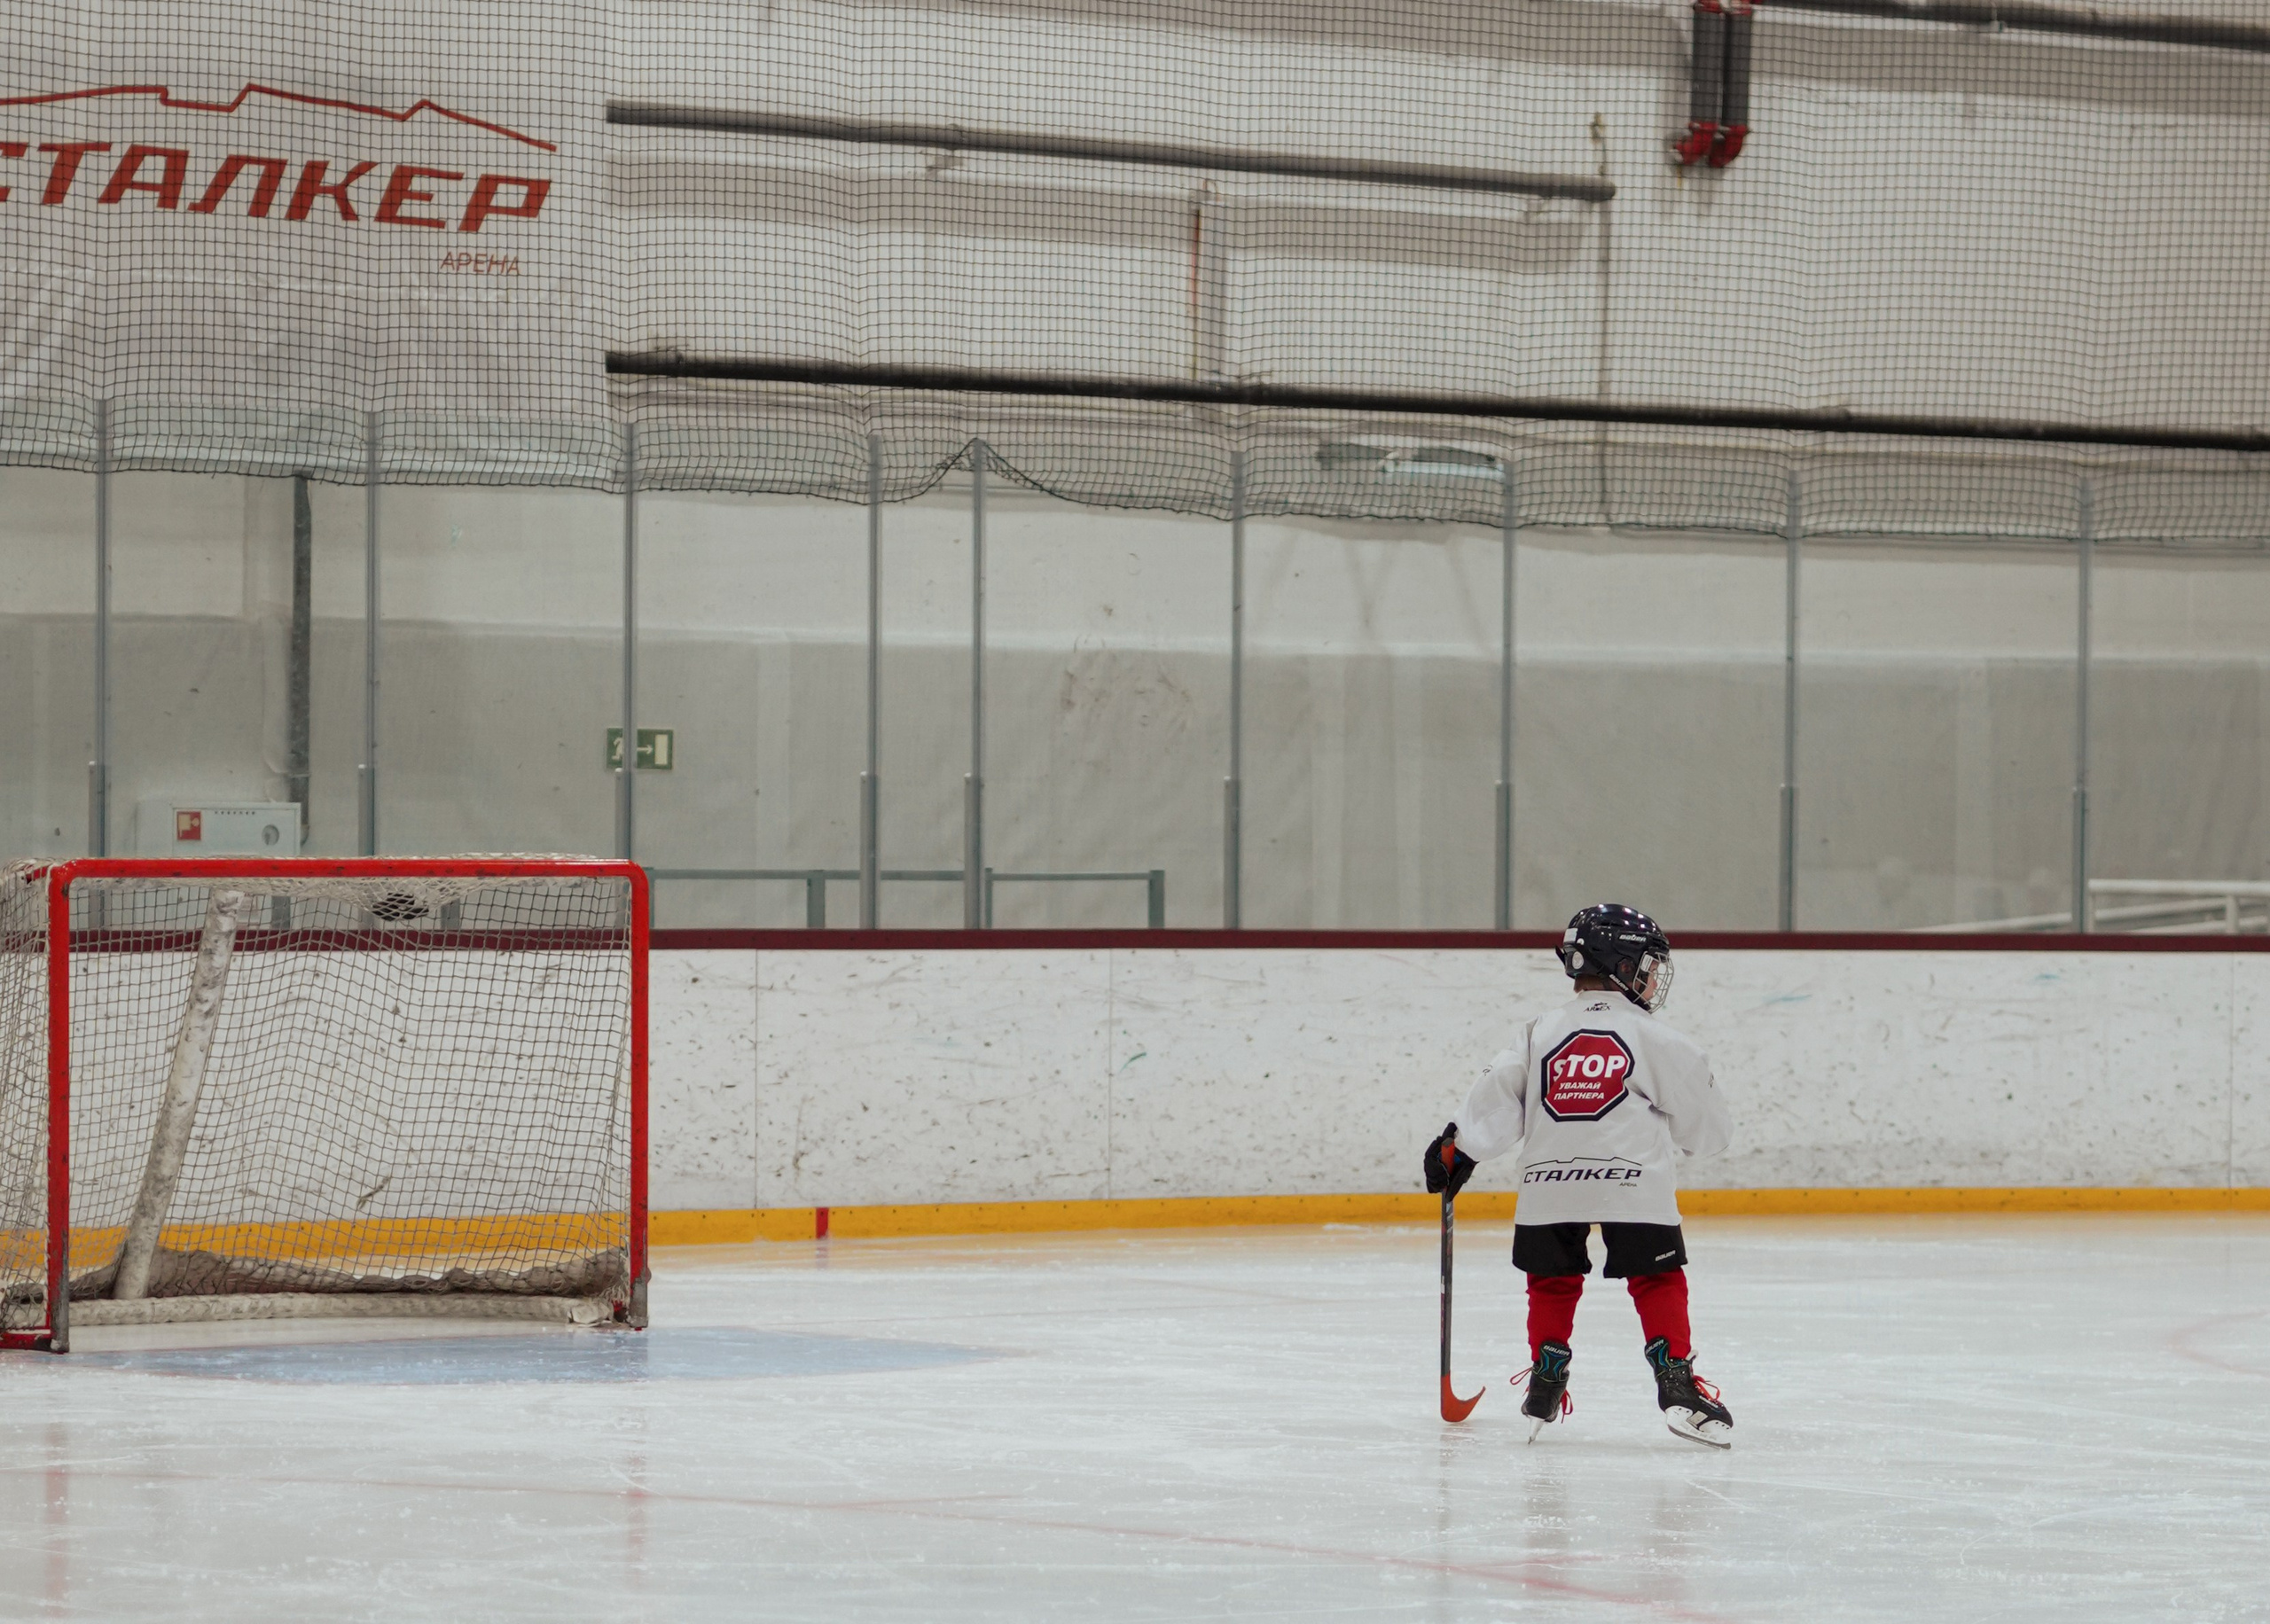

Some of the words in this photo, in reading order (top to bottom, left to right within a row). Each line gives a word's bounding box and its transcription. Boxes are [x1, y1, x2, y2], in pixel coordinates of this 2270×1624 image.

[441, 252, 521, 275] АРЕНА
[1554, 1054, 1626, 1081] STOP
[1524, 1168, 1642, 1183] СТАЛКЕР
